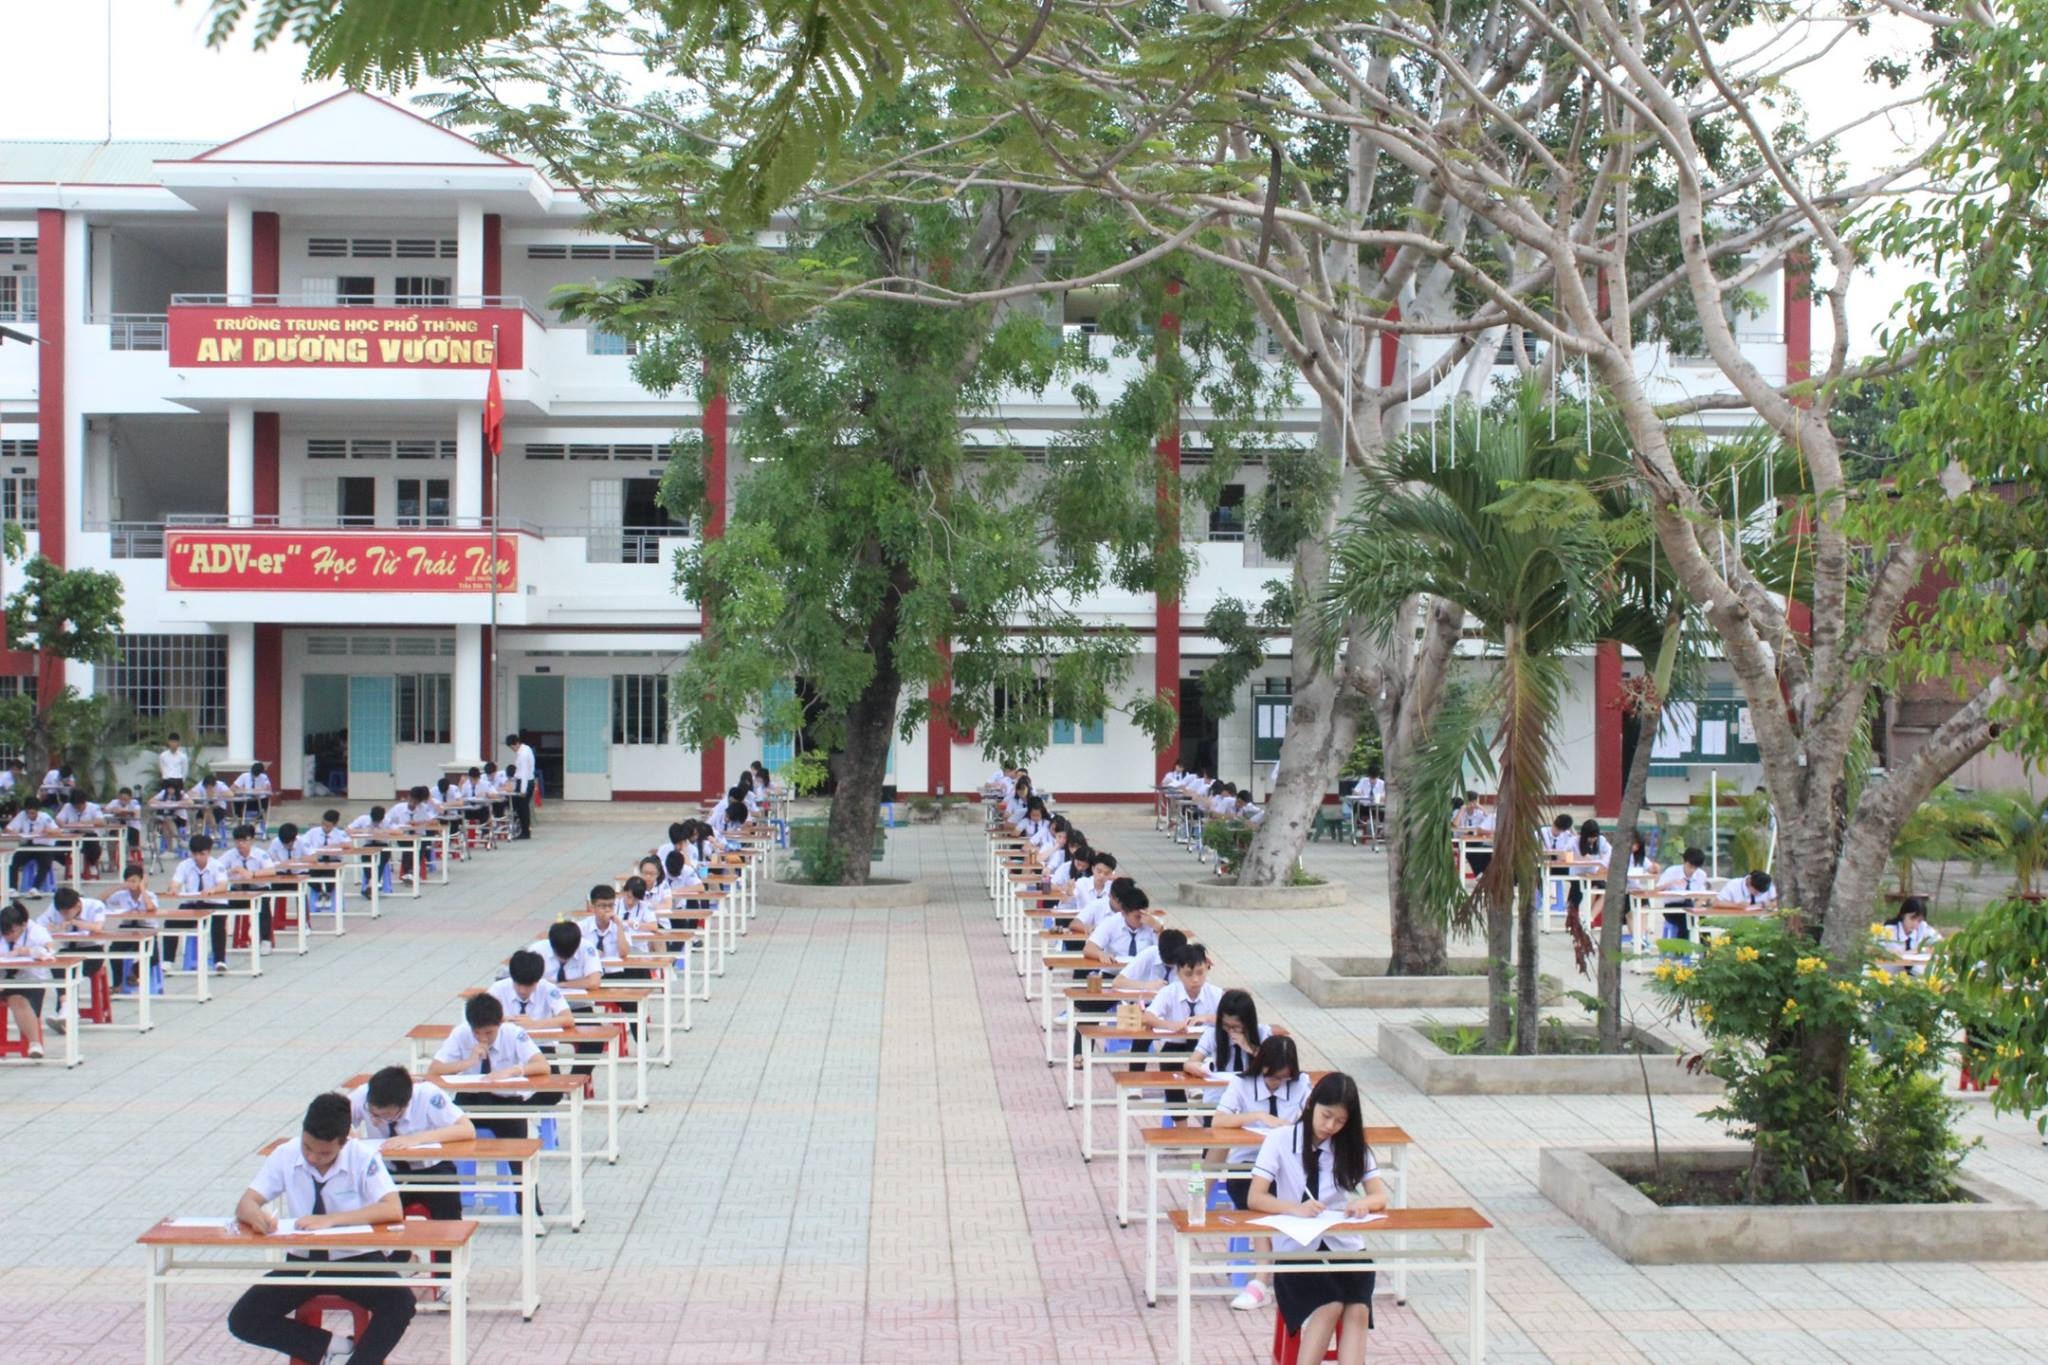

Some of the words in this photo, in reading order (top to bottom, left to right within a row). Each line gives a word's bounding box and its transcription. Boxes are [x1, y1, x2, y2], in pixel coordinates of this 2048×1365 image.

[214, 315, 281, 331] TRƯỜNG
[285, 319, 341, 331] TRUNG
[344, 319, 379, 334] HỌC
[383, 314, 419, 332] PHỔ
[422, 317, 478, 332] THÔNG
[196, 337, 243, 362] AN
[253, 334, 368, 363] DƯƠNG
[378, 335, 495, 364] VƯƠNG
[311, 546, 357, 582] Học
[366, 546, 401, 576] Từ
[406, 546, 457, 576] Trái
[465, 546, 511, 576] Tim
